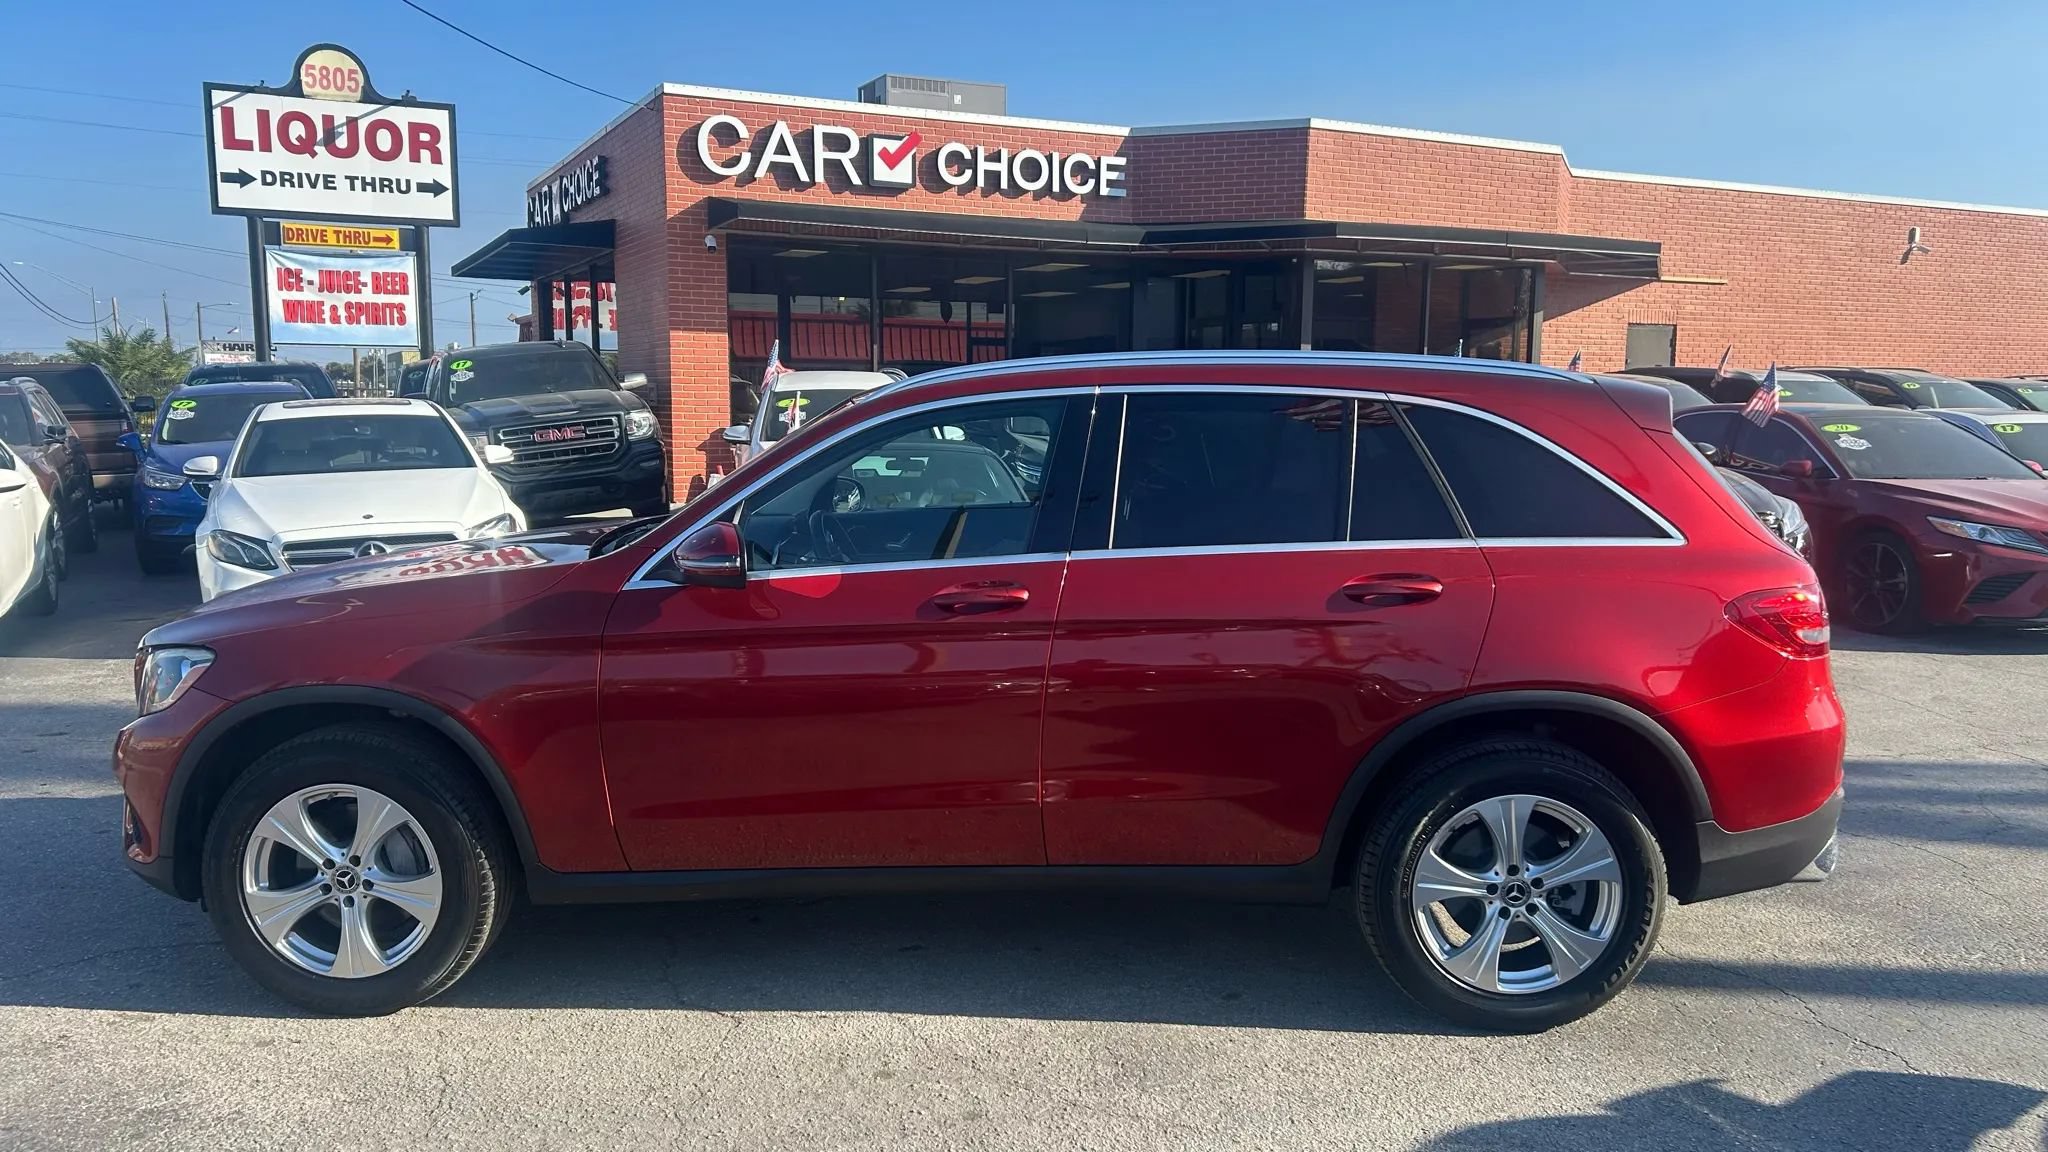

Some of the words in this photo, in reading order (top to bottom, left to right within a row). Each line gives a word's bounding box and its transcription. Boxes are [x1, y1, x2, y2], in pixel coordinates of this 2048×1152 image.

[304, 64, 360, 93] 5805
[220, 105, 443, 165] LIQUOR
[697, 115, 863, 187] CAR
[937, 141, 1127, 197] CHOICE
[260, 169, 337, 190] DRIVE
[344, 174, 412, 195] THRU
[562, 155, 601, 213] CHOICE
[285, 226, 328, 243] DRIVE
[333, 230, 371, 245] THRU
[276, 267, 304, 292] ICE
[371, 271, 409, 295] BEER
[282, 299, 326, 324] WINE
[329, 304, 341, 324] &
[344, 301, 407, 326] SPIRITS
[534, 425, 586, 442] GMC
